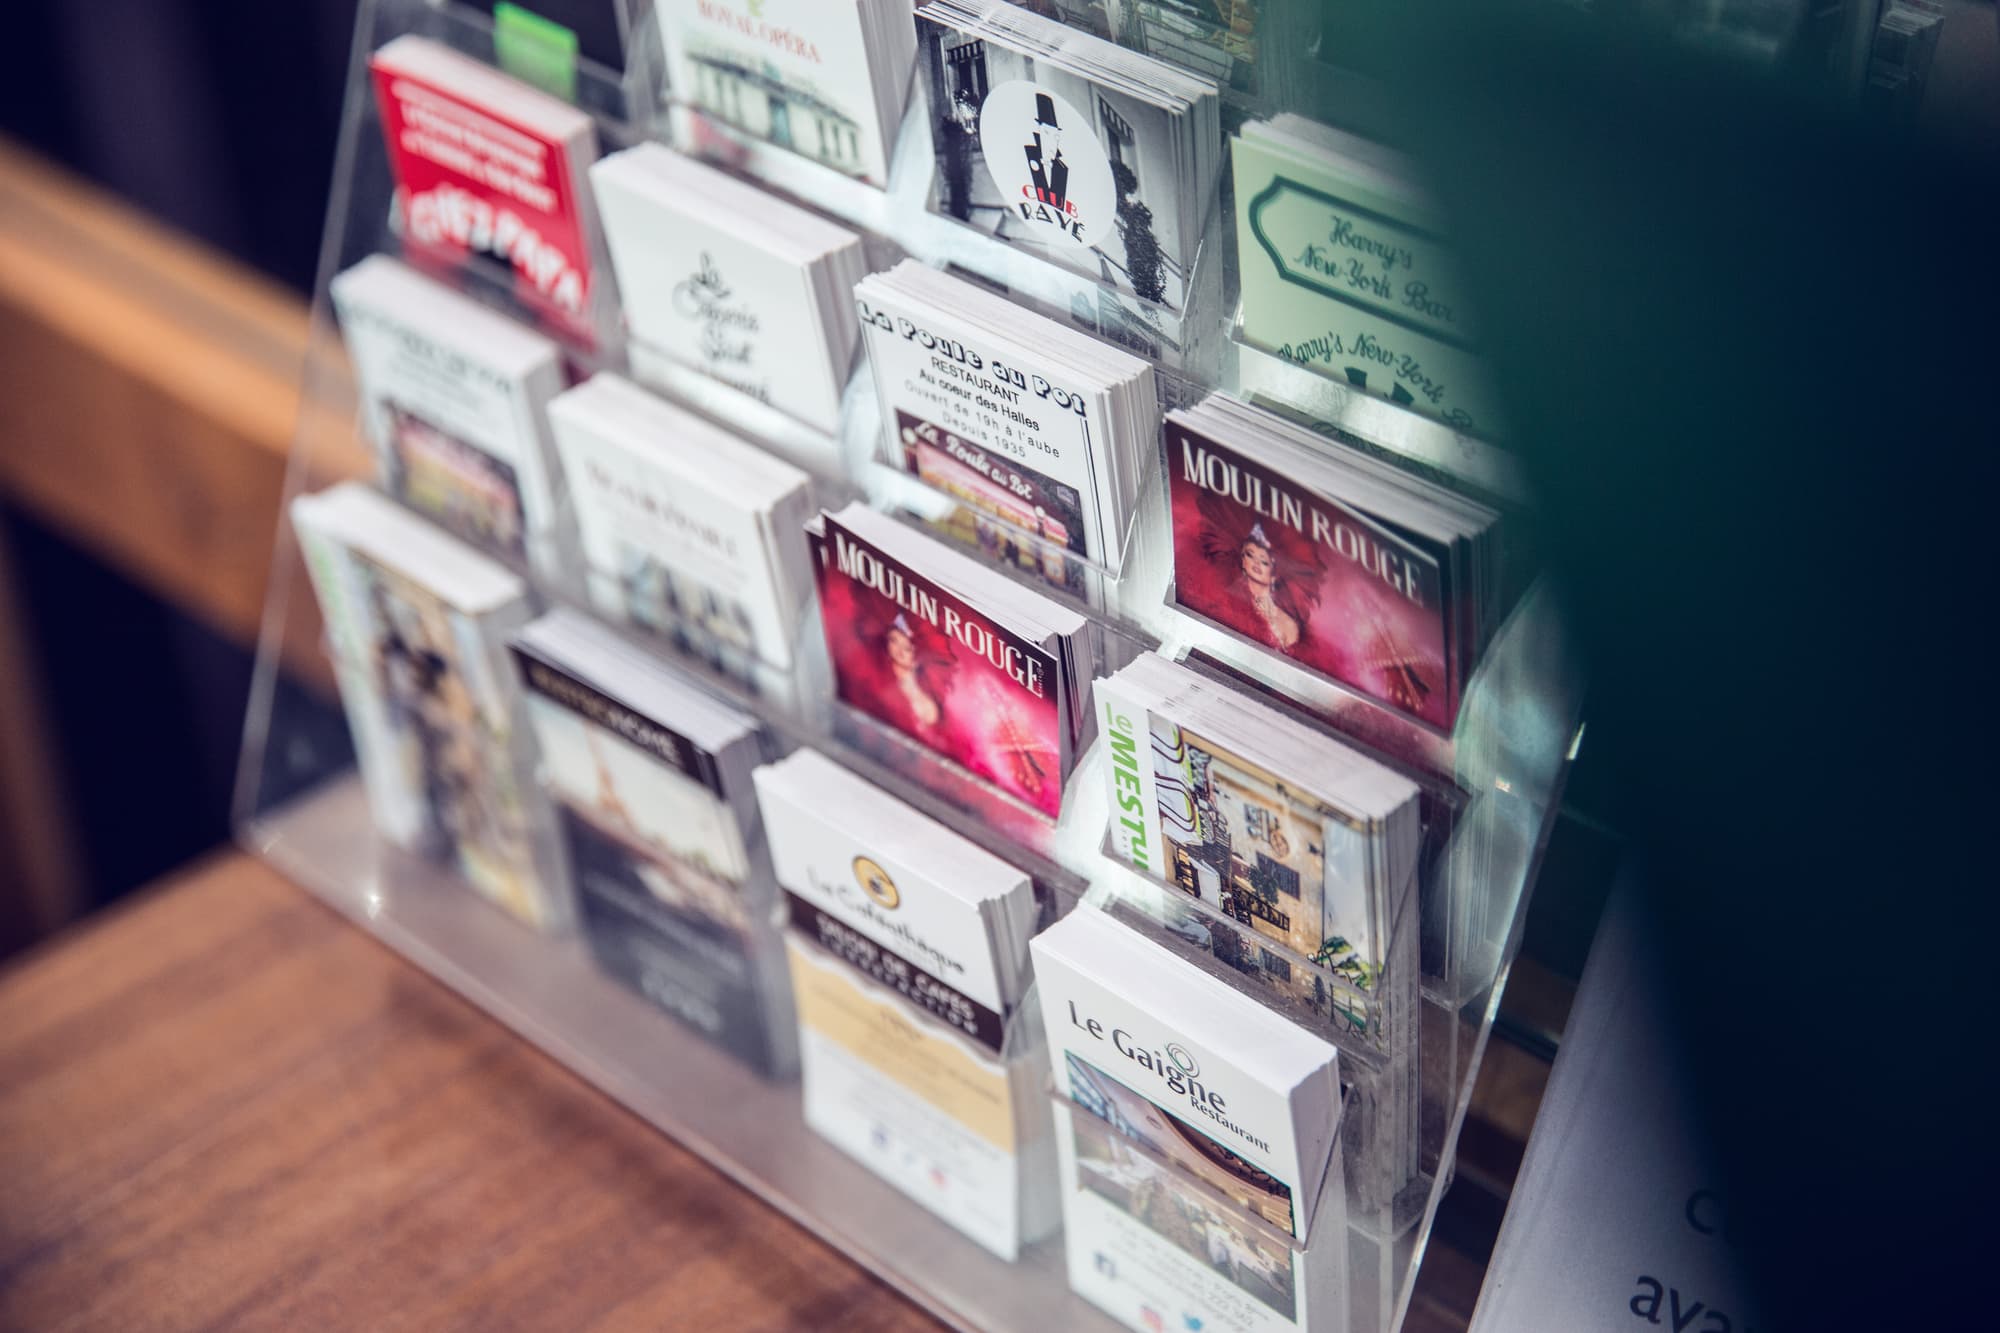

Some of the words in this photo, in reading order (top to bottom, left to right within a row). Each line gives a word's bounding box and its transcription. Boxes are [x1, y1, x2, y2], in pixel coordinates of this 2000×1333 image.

[1022, 184, 1079, 219] CLUB
[1329, 214, 1414, 271] Harry's
[857, 301, 893, 333] La
[897, 317, 983, 370] Poule
[992, 360, 1027, 391] au
[1031, 374, 1088, 418] Pot
[930, 355, 1020, 405] RESTAURANT
[1347, 333, 1444, 404] New-York
[904, 379, 953, 405] Ouvert
[954, 401, 970, 417] de
[976, 411, 1000, 432] 19h
[1018, 431, 1062, 459] l'aube
[919, 368, 936, 385] Au
[975, 394, 998, 415] des
[1001, 407, 1041, 432] Halles
[942, 412, 989, 440] Depuis
[993, 434, 1027, 459] 1935
[945, 434, 991, 477] Poule
[1181, 437, 1303, 533] MOULIN
[1310, 506, 1424, 609] ROUGE
[834, 531, 940, 628] MOULIN
[942, 604, 1045, 700] ROUGE
[1068, 999, 1105, 1041] Le
[1112, 1028, 1227, 1115] Gaigne
[1190, 1095, 1271, 1155] Restaurant
